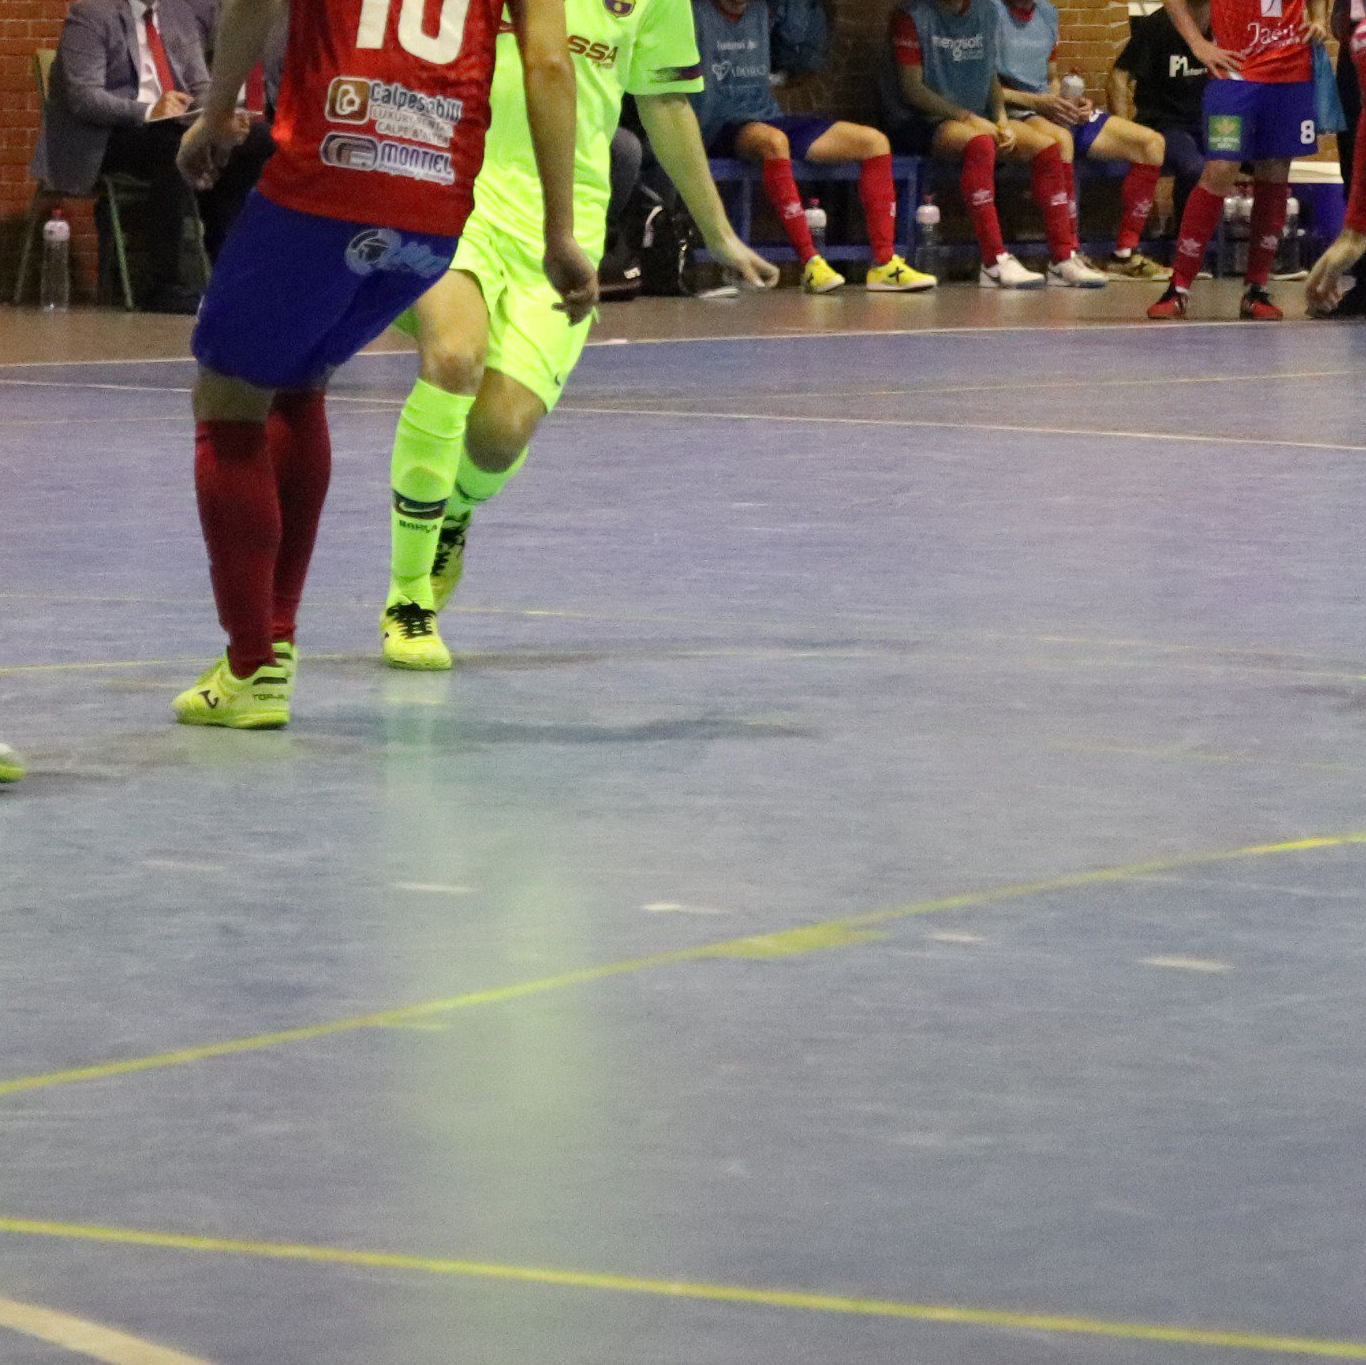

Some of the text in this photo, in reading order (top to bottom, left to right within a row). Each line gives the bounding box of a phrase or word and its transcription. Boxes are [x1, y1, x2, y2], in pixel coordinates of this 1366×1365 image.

[567, 35, 618, 63] SSA
[1300, 120, 1315, 144] 8
[381, 143, 452, 174] MONTIEL
